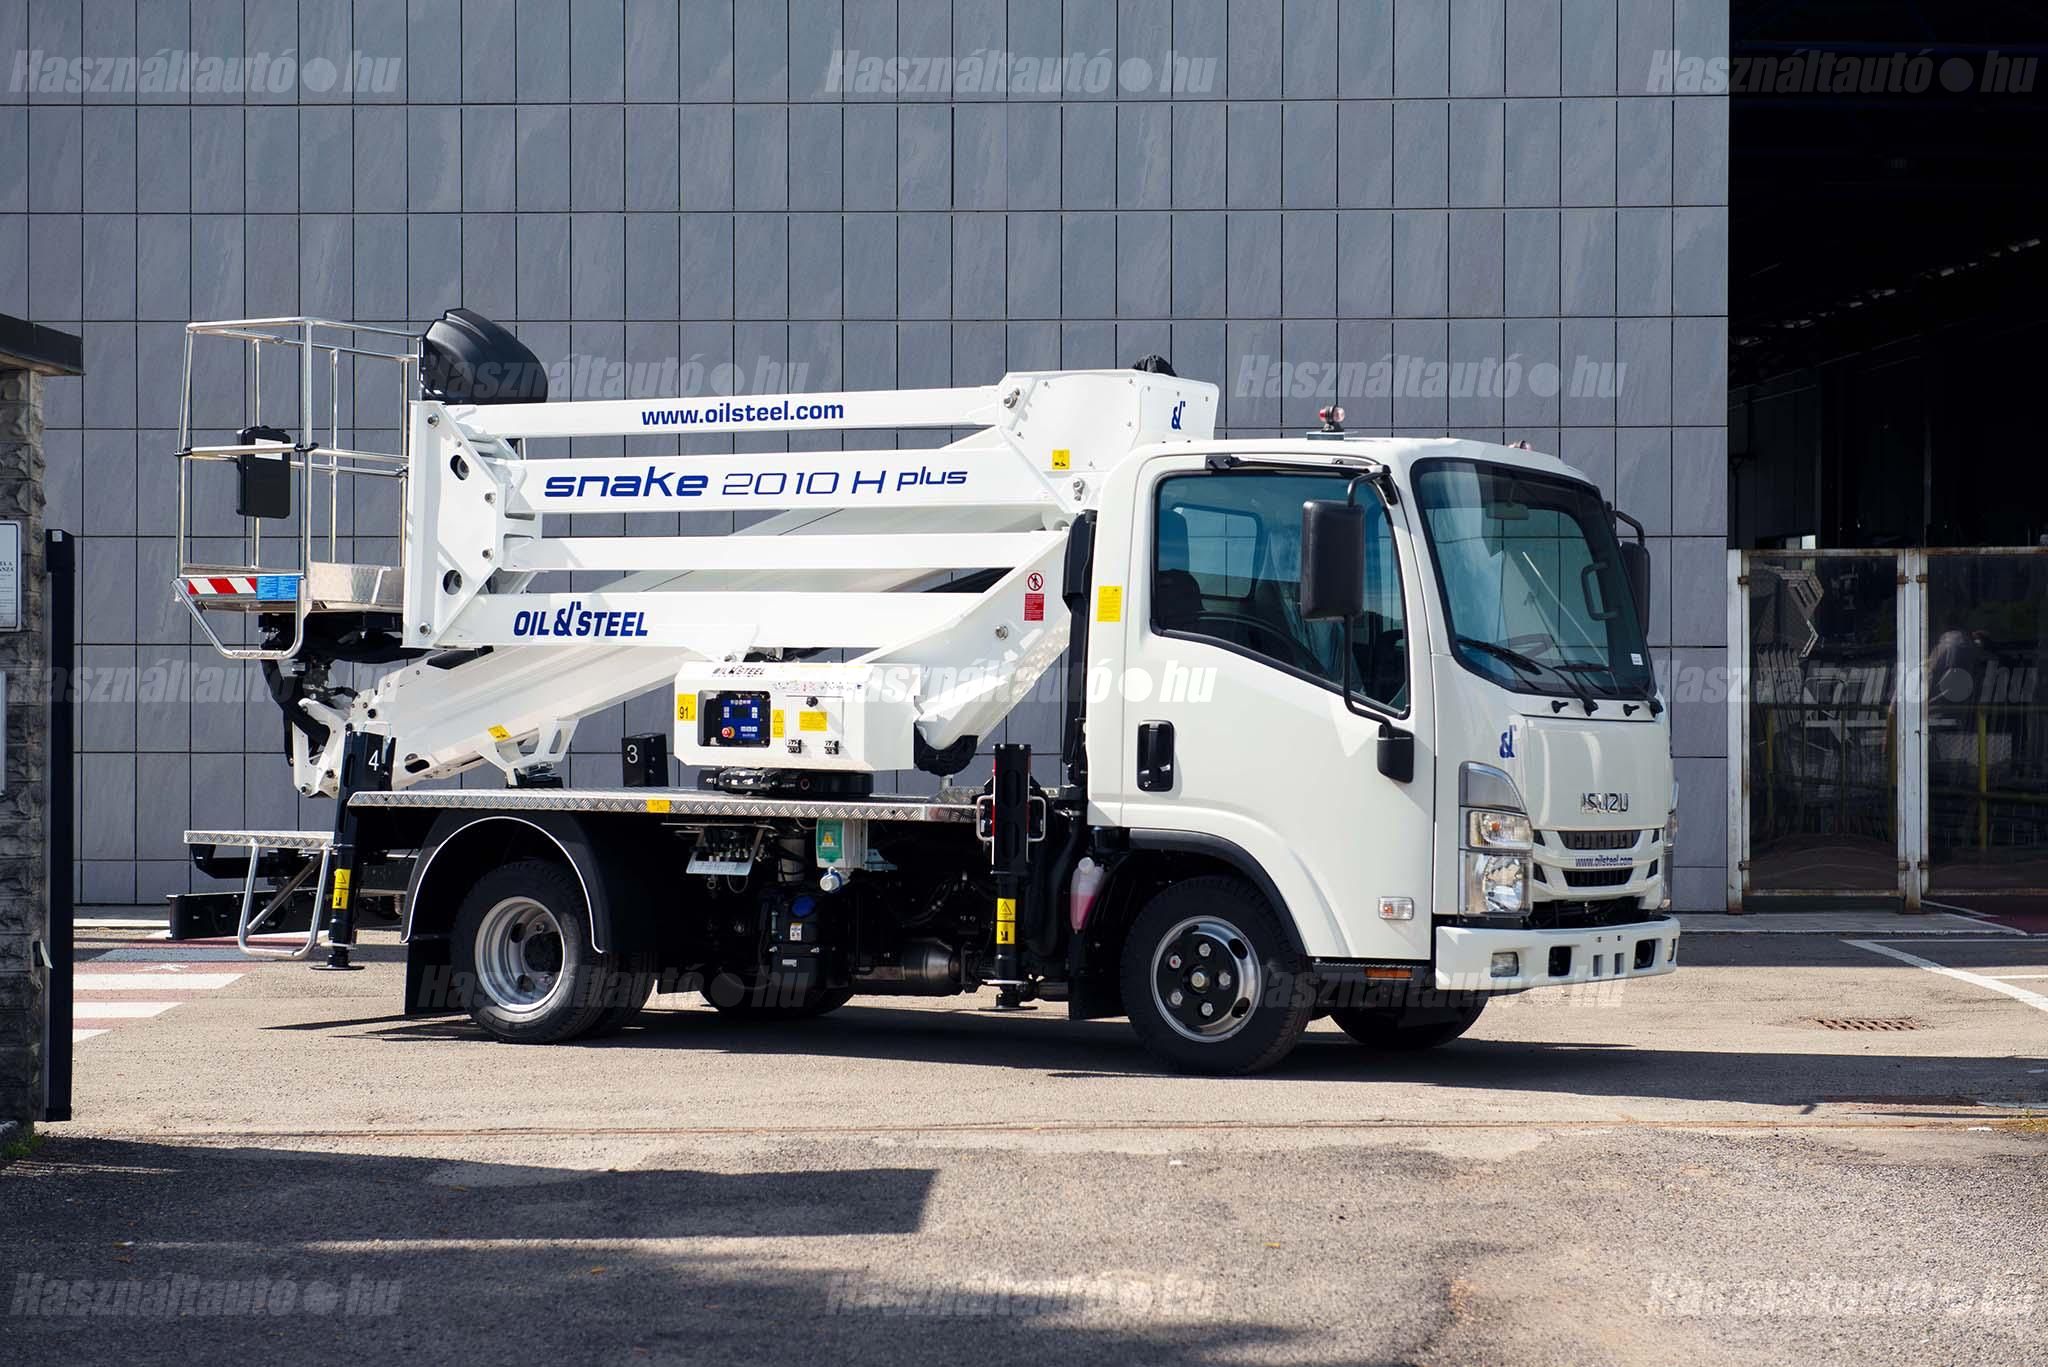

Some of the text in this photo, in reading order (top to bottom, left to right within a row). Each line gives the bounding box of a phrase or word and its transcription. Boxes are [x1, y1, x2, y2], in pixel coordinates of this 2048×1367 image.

[641, 400, 844, 425] www.oilsteel.com
[544, 465, 968, 498] snake 2010 H plus
[368, 750, 380, 772] 4
[627, 745, 639, 764] 3
[1582, 793, 1630, 813] ISUZU
[1575, 854, 1633, 867] www.oilsteel.com
